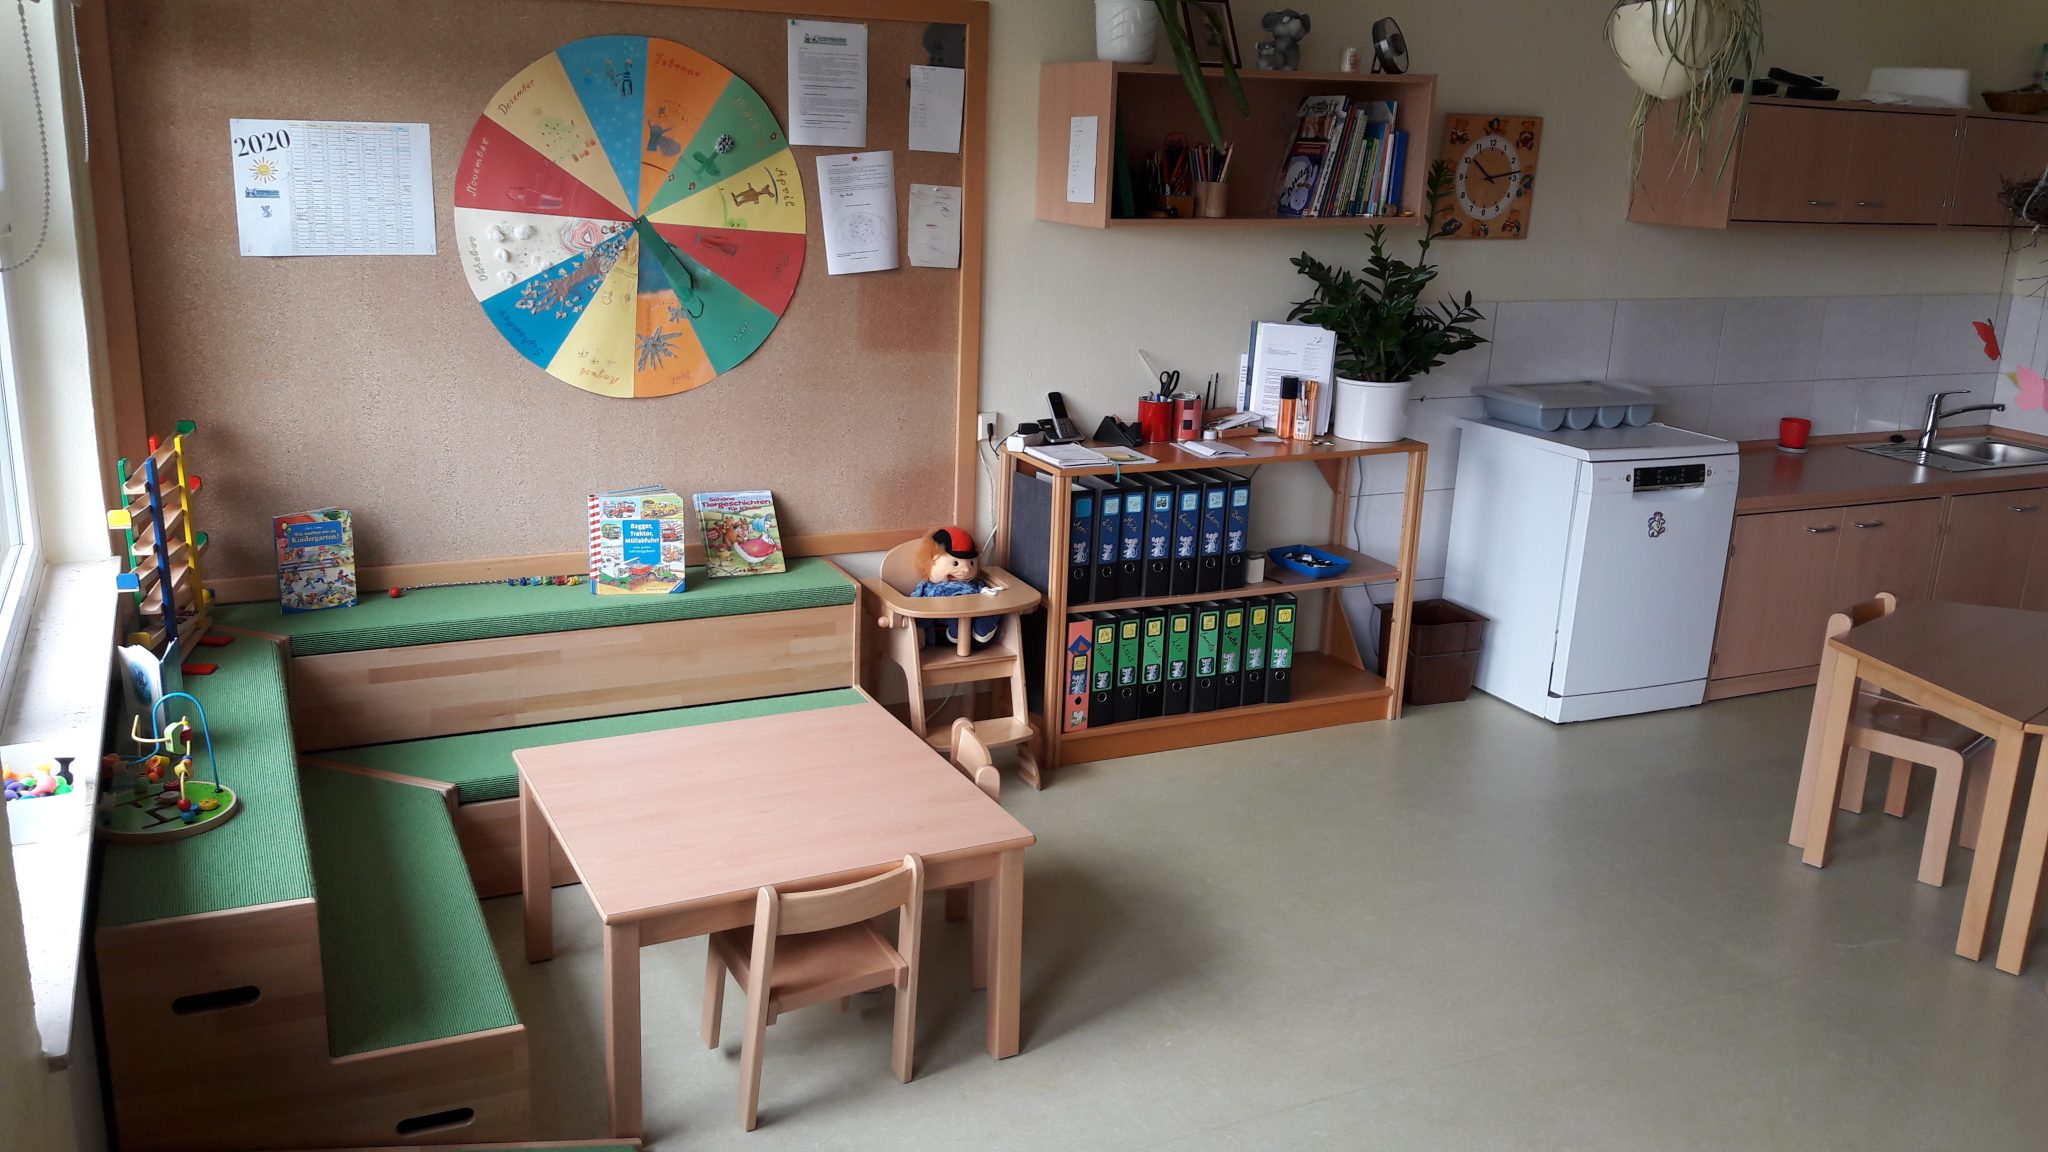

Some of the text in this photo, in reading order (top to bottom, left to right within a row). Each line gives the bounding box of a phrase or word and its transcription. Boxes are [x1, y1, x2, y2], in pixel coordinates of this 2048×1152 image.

[233, 128, 291, 158] 2020
[1476, 143, 1482, 151] 11
[1490, 139, 1497, 147] 12
[1459, 173, 1464, 181] 9
[1512, 174, 1517, 182] 3
[776, 167, 795, 207] April
[1460, 191, 1466, 199] 8
[1506, 191, 1511, 199] 4
[1469, 205, 1474, 213] 7
[1481, 208, 1486, 216] 6
[1495, 204, 1500, 212] 5
[702, 500, 771, 509] Tiergeschichten
[630, 523, 653, 531] Bagger,
